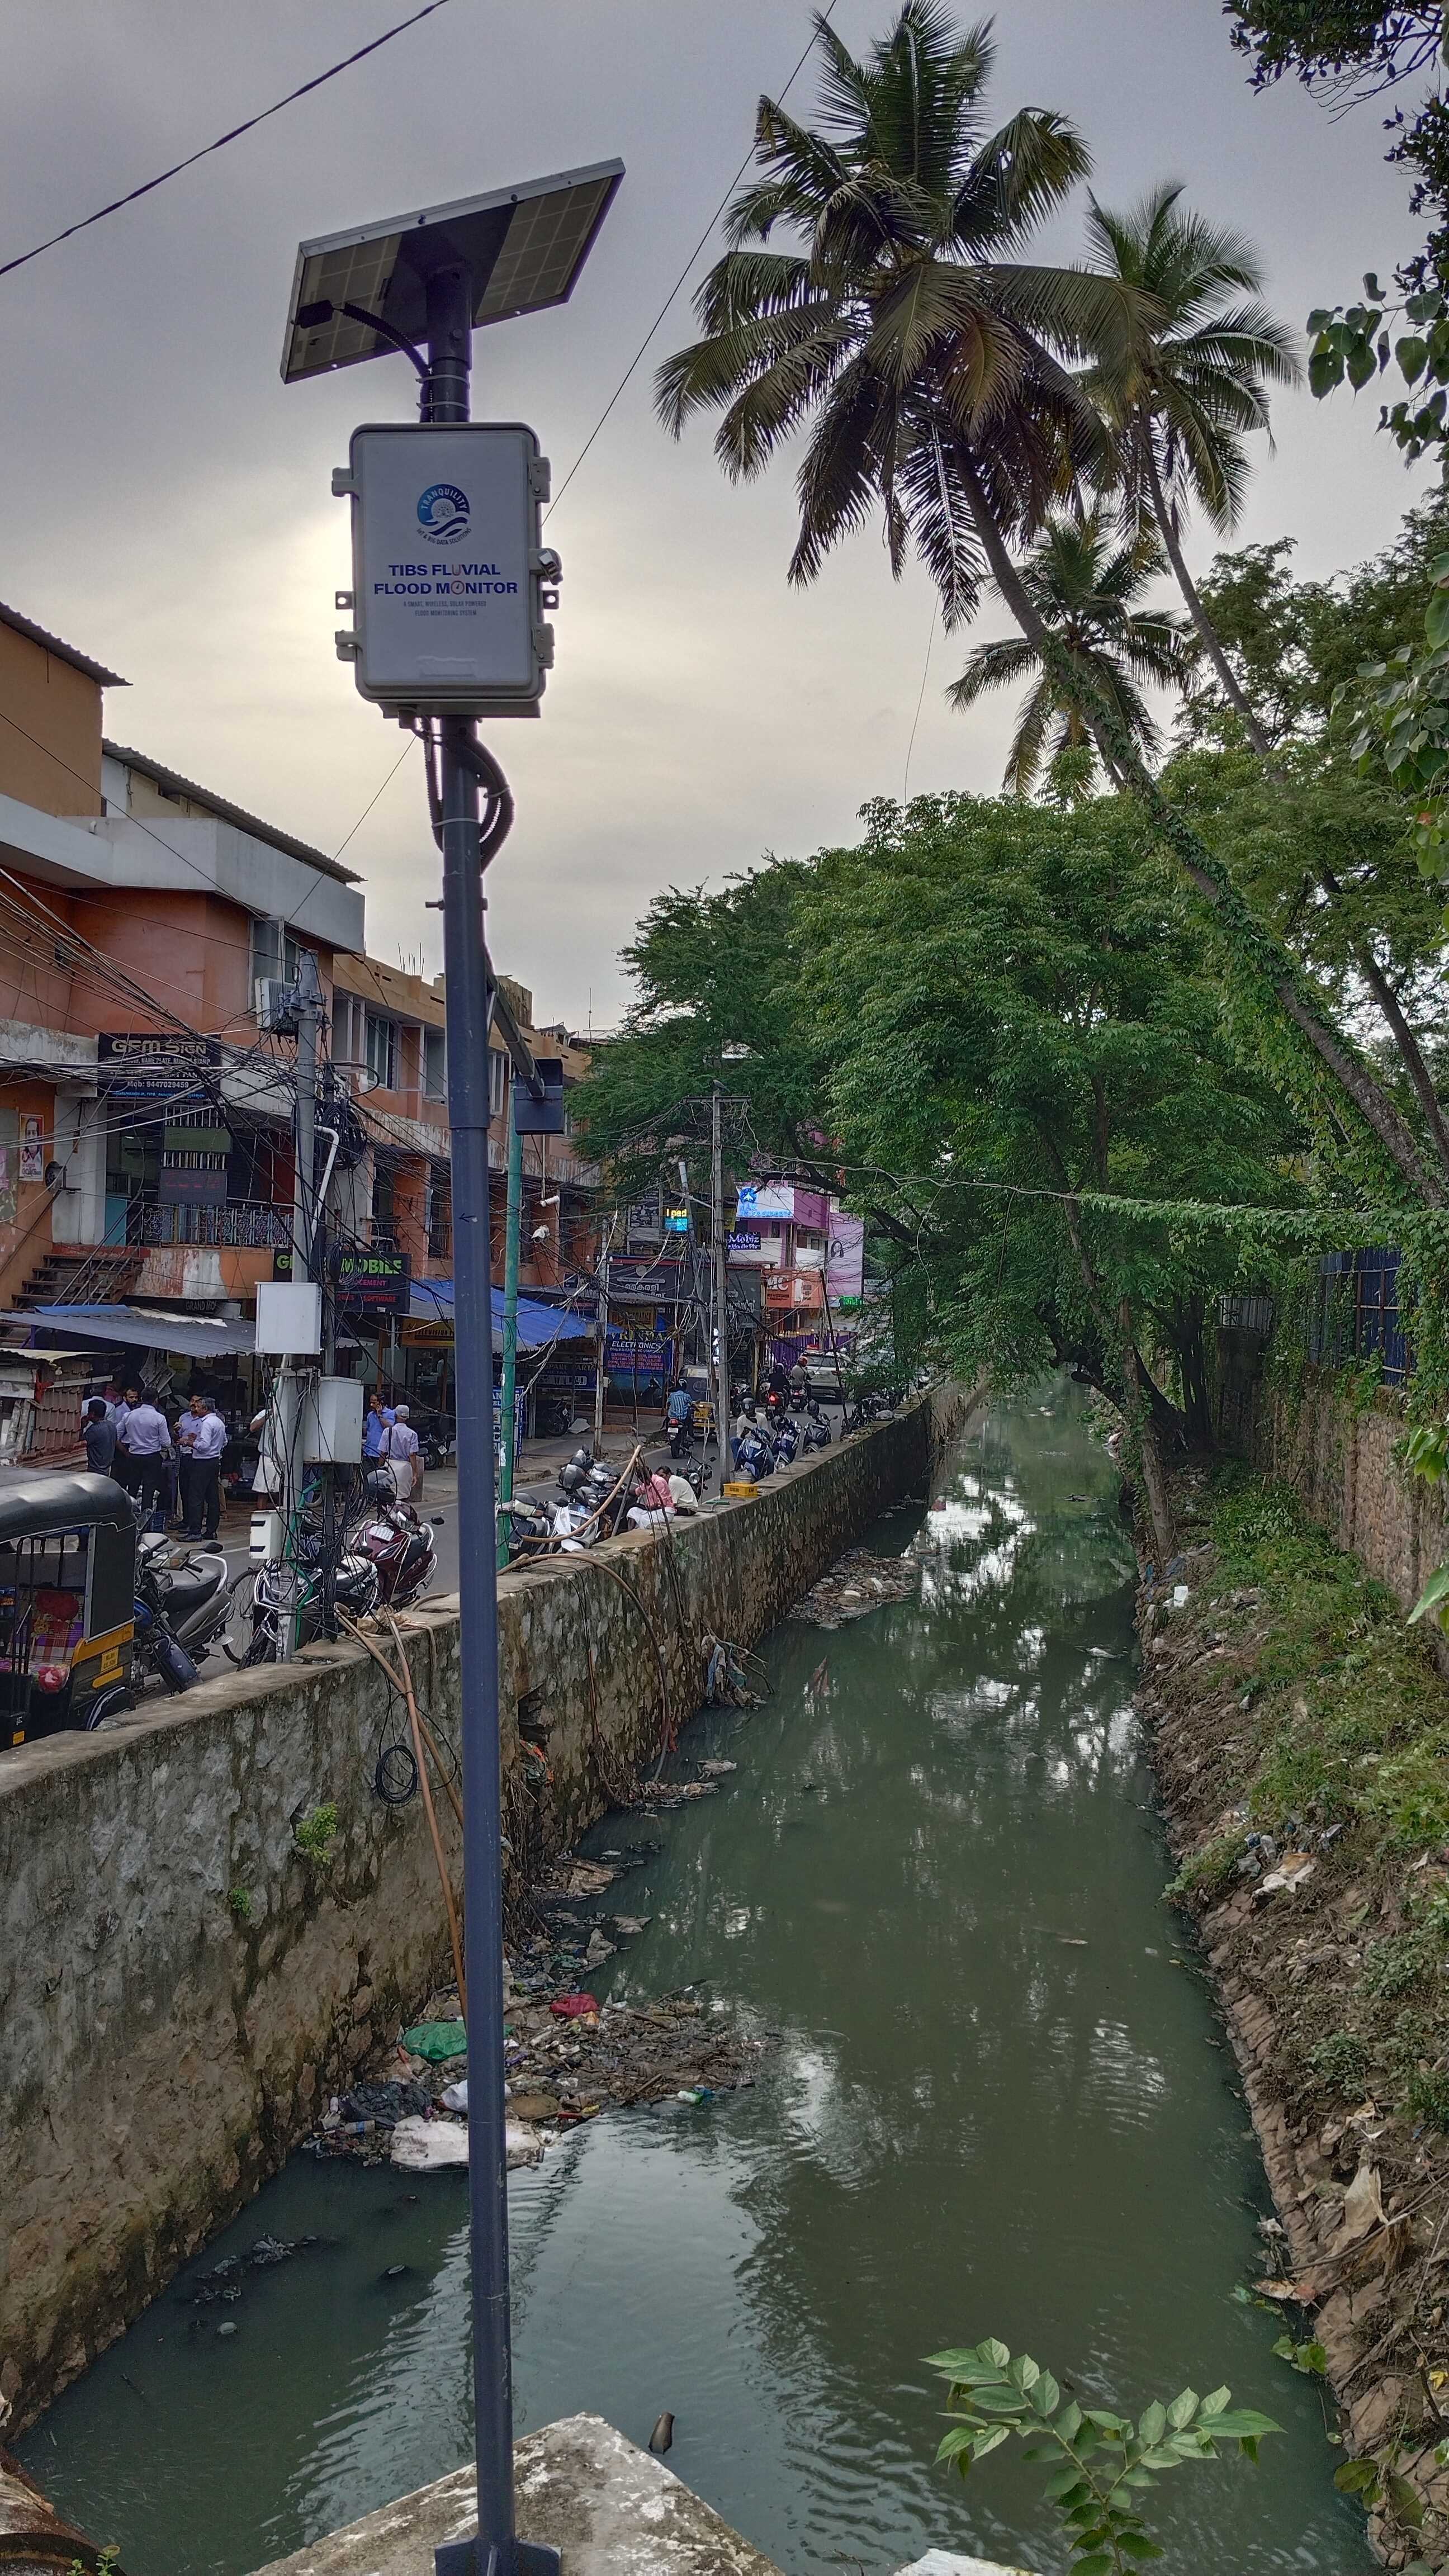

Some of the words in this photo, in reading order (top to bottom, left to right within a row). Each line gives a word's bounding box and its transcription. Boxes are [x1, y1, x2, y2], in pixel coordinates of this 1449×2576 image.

[421, 487, 467, 510] TRANQUILITY
[427, 536, 436, 544] BIG
[449, 527, 472, 545] SOLUTIONS
[389, 564, 428, 576] TIBS
[432, 564, 501, 576] FLUVIAL
[374, 583, 432, 595] FLOOD
[436, 580, 518, 595] MONITOR
[206, 1300, 217, 1311] MO
